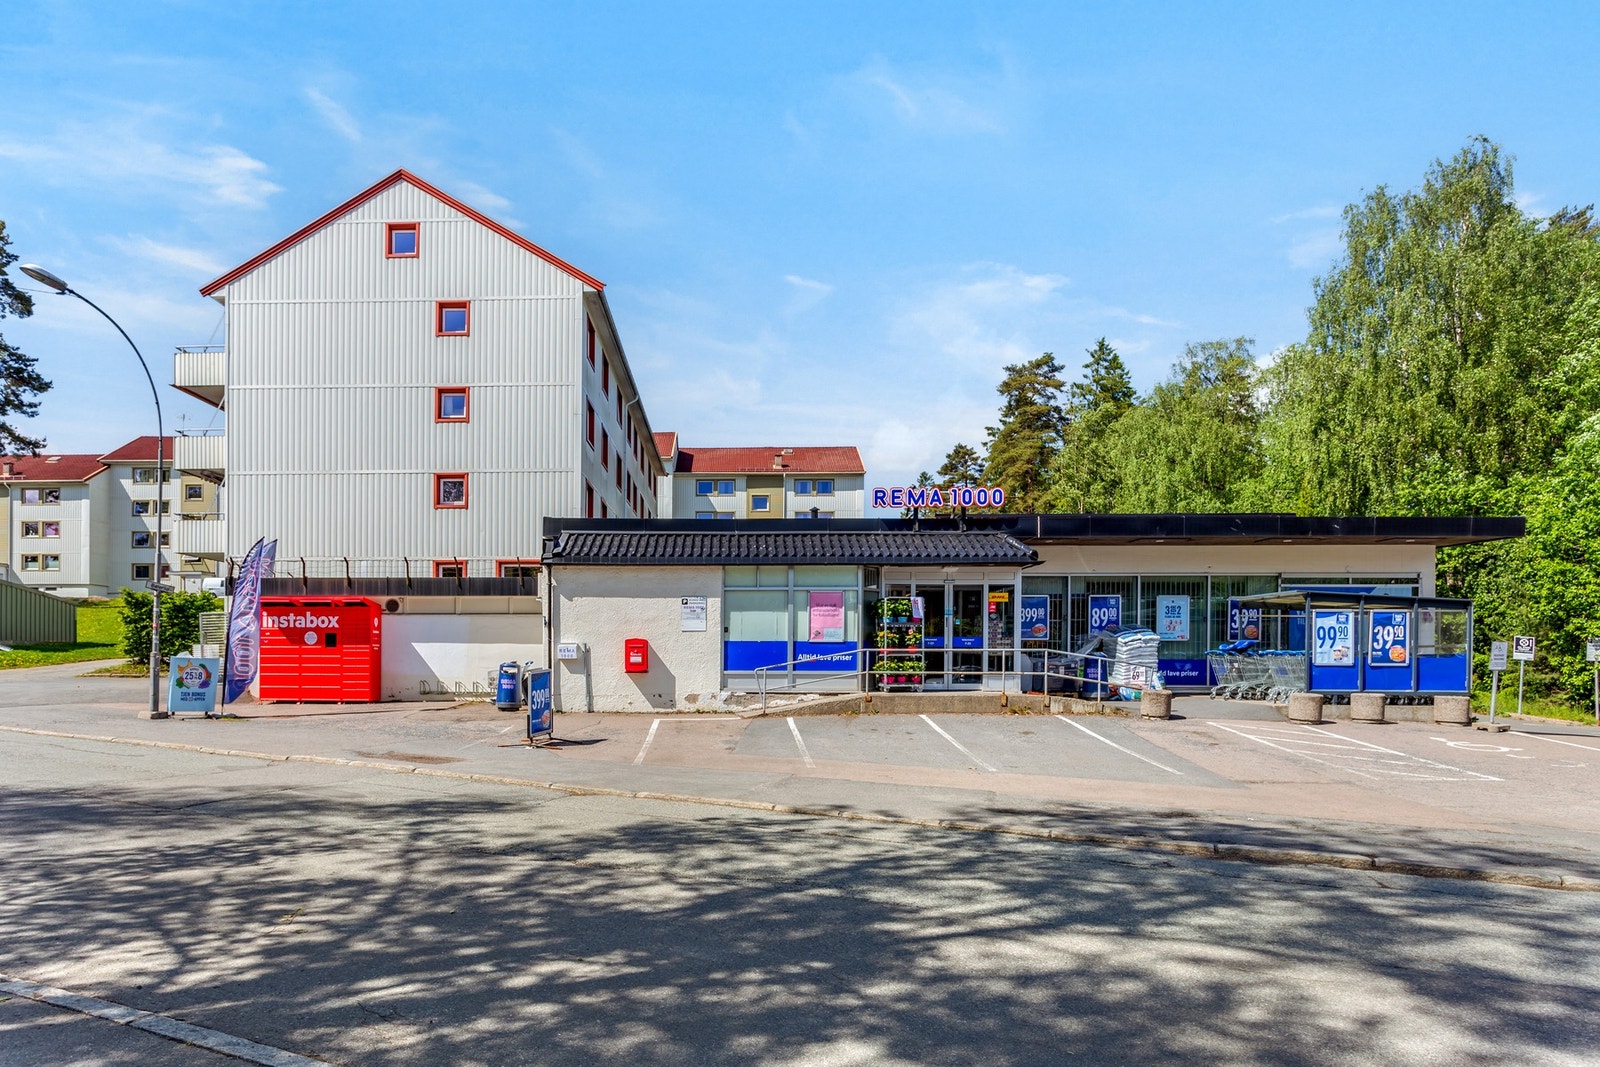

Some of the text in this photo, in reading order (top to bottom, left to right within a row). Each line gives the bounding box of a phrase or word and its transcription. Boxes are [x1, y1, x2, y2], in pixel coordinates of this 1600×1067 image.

[873, 487, 1005, 507] REMA 1000
[1092, 607, 1108, 627] 89
[1164, 605, 1170, 615] 3
[1176, 605, 1182, 615] 2
[262, 611, 339, 628] instabox
[1232, 609, 1248, 629] 39
[1317, 625, 1348, 649] 99 90
[1373, 625, 1404, 650] 39 90
[798, 653, 817, 661] Alltid
[833, 654, 853, 662] priser
[184, 671, 194, 680] 25
[197, 671, 203, 680] 8
[1131, 671, 1140, 681] 69
[532, 689, 545, 710] 399
